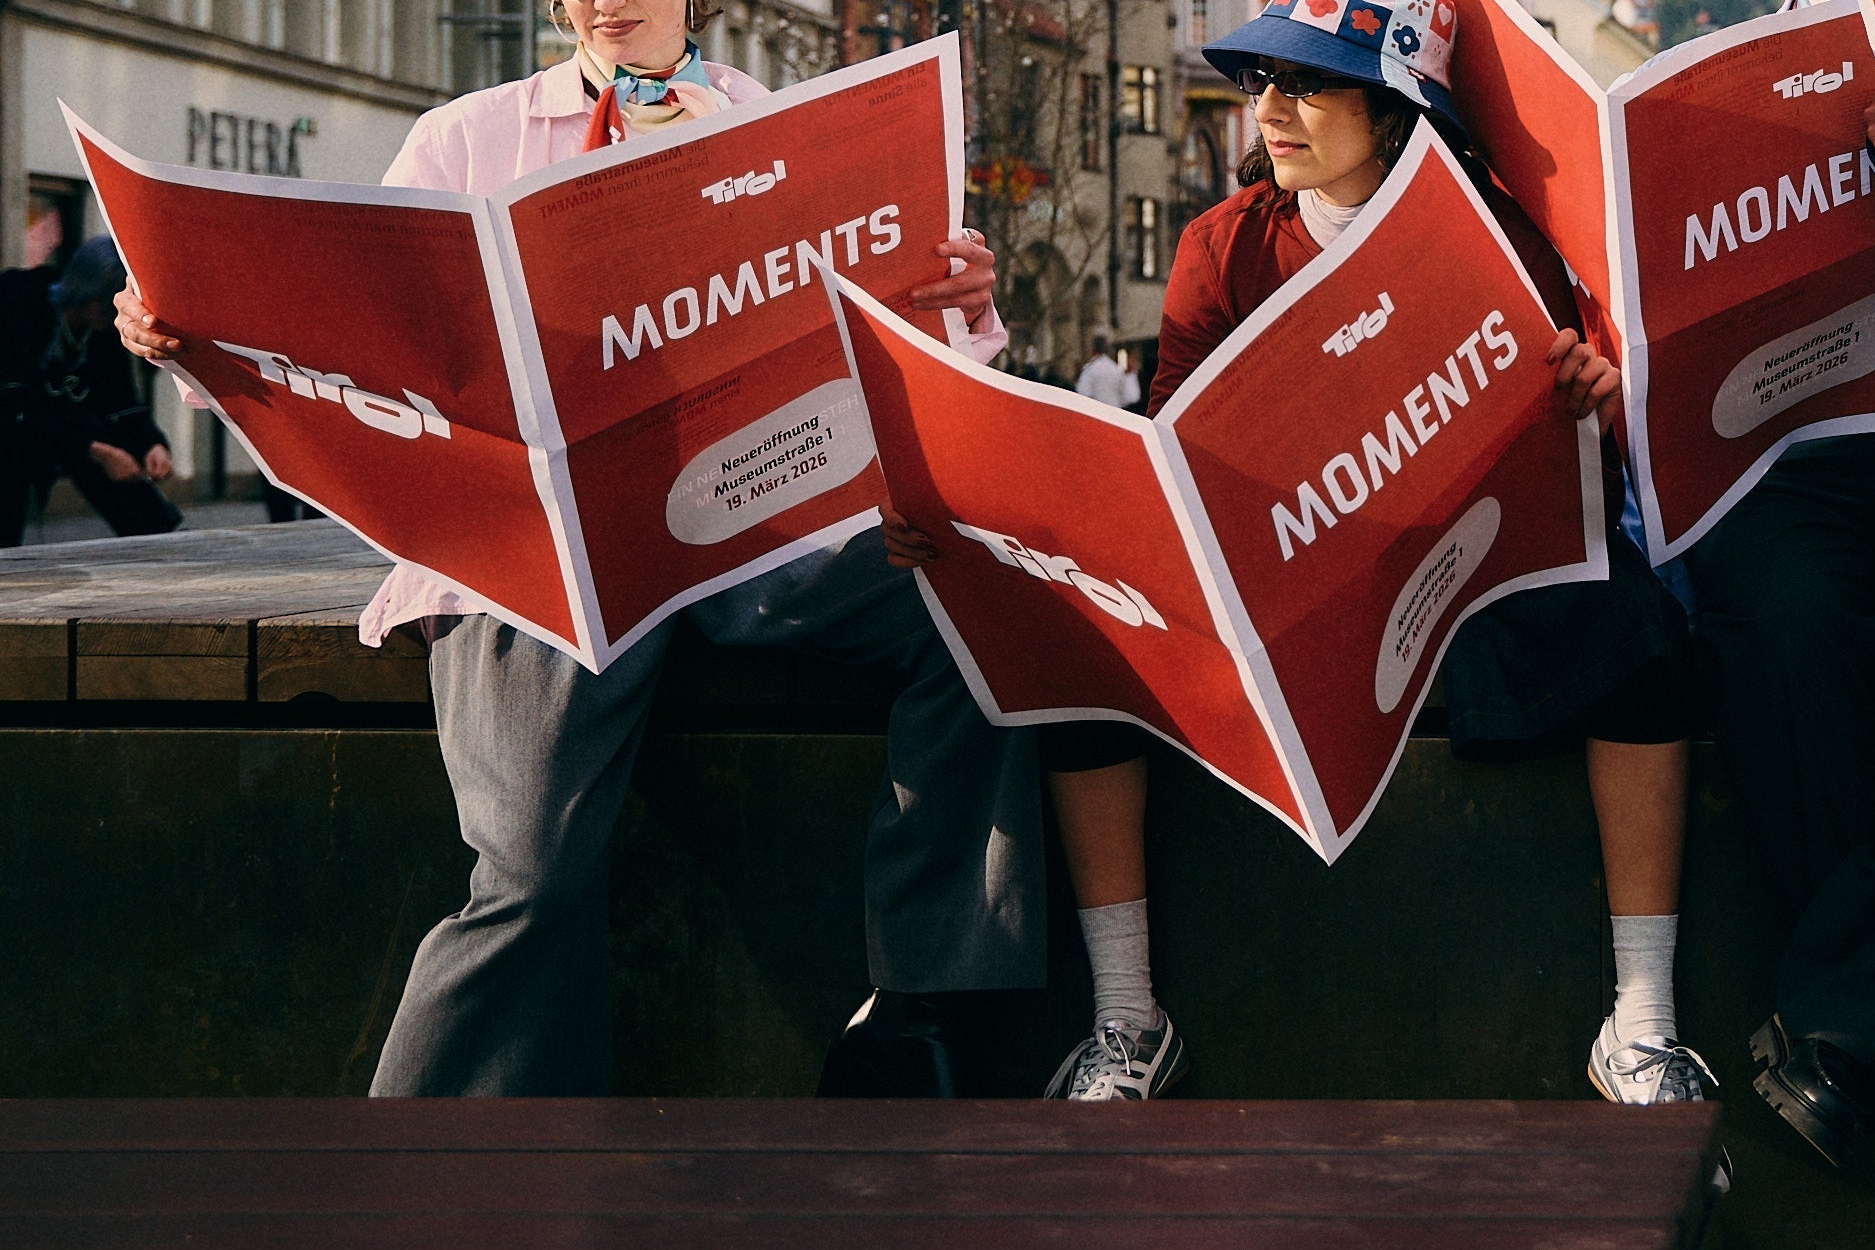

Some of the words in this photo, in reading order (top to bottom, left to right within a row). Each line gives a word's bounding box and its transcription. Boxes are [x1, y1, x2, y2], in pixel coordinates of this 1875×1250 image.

[1773, 62, 1853, 99] Tirol
[701, 160, 786, 204] Tirol
[602, 204, 901, 370] MOMENTS
[1322, 292, 1394, 357] Tirol
[1763, 321, 1854, 372] Neueröffnung
[213, 340, 451, 439] Tirol
[1752, 337, 1851, 393] Museumstraße
[1854, 331, 1861, 343] 1
[1759, 391, 1776, 405] 19.
[1778, 373, 1813, 395] März
[1815, 352, 1849, 376] 2026
[714, 434, 825, 498] Museumstraße
[825, 427, 833, 440] 1
[721, 415, 819, 475] Neueröffnung
[1271, 310, 1518, 561] MOMENTS
[725, 494, 747, 511] 19.
[750, 475, 789, 500] März
[791, 452, 828, 480] 2026
[951, 521, 1168, 630] Tirol
[1395, 557, 1457, 657] Museumstraße
[1459, 546, 1464, 558] 1
[1397, 542, 1457, 631] Neueröffnung
[1401, 645, 1413, 662] 19.
[1412, 607, 1432, 642] März
[1433, 570, 1456, 604] 2026
